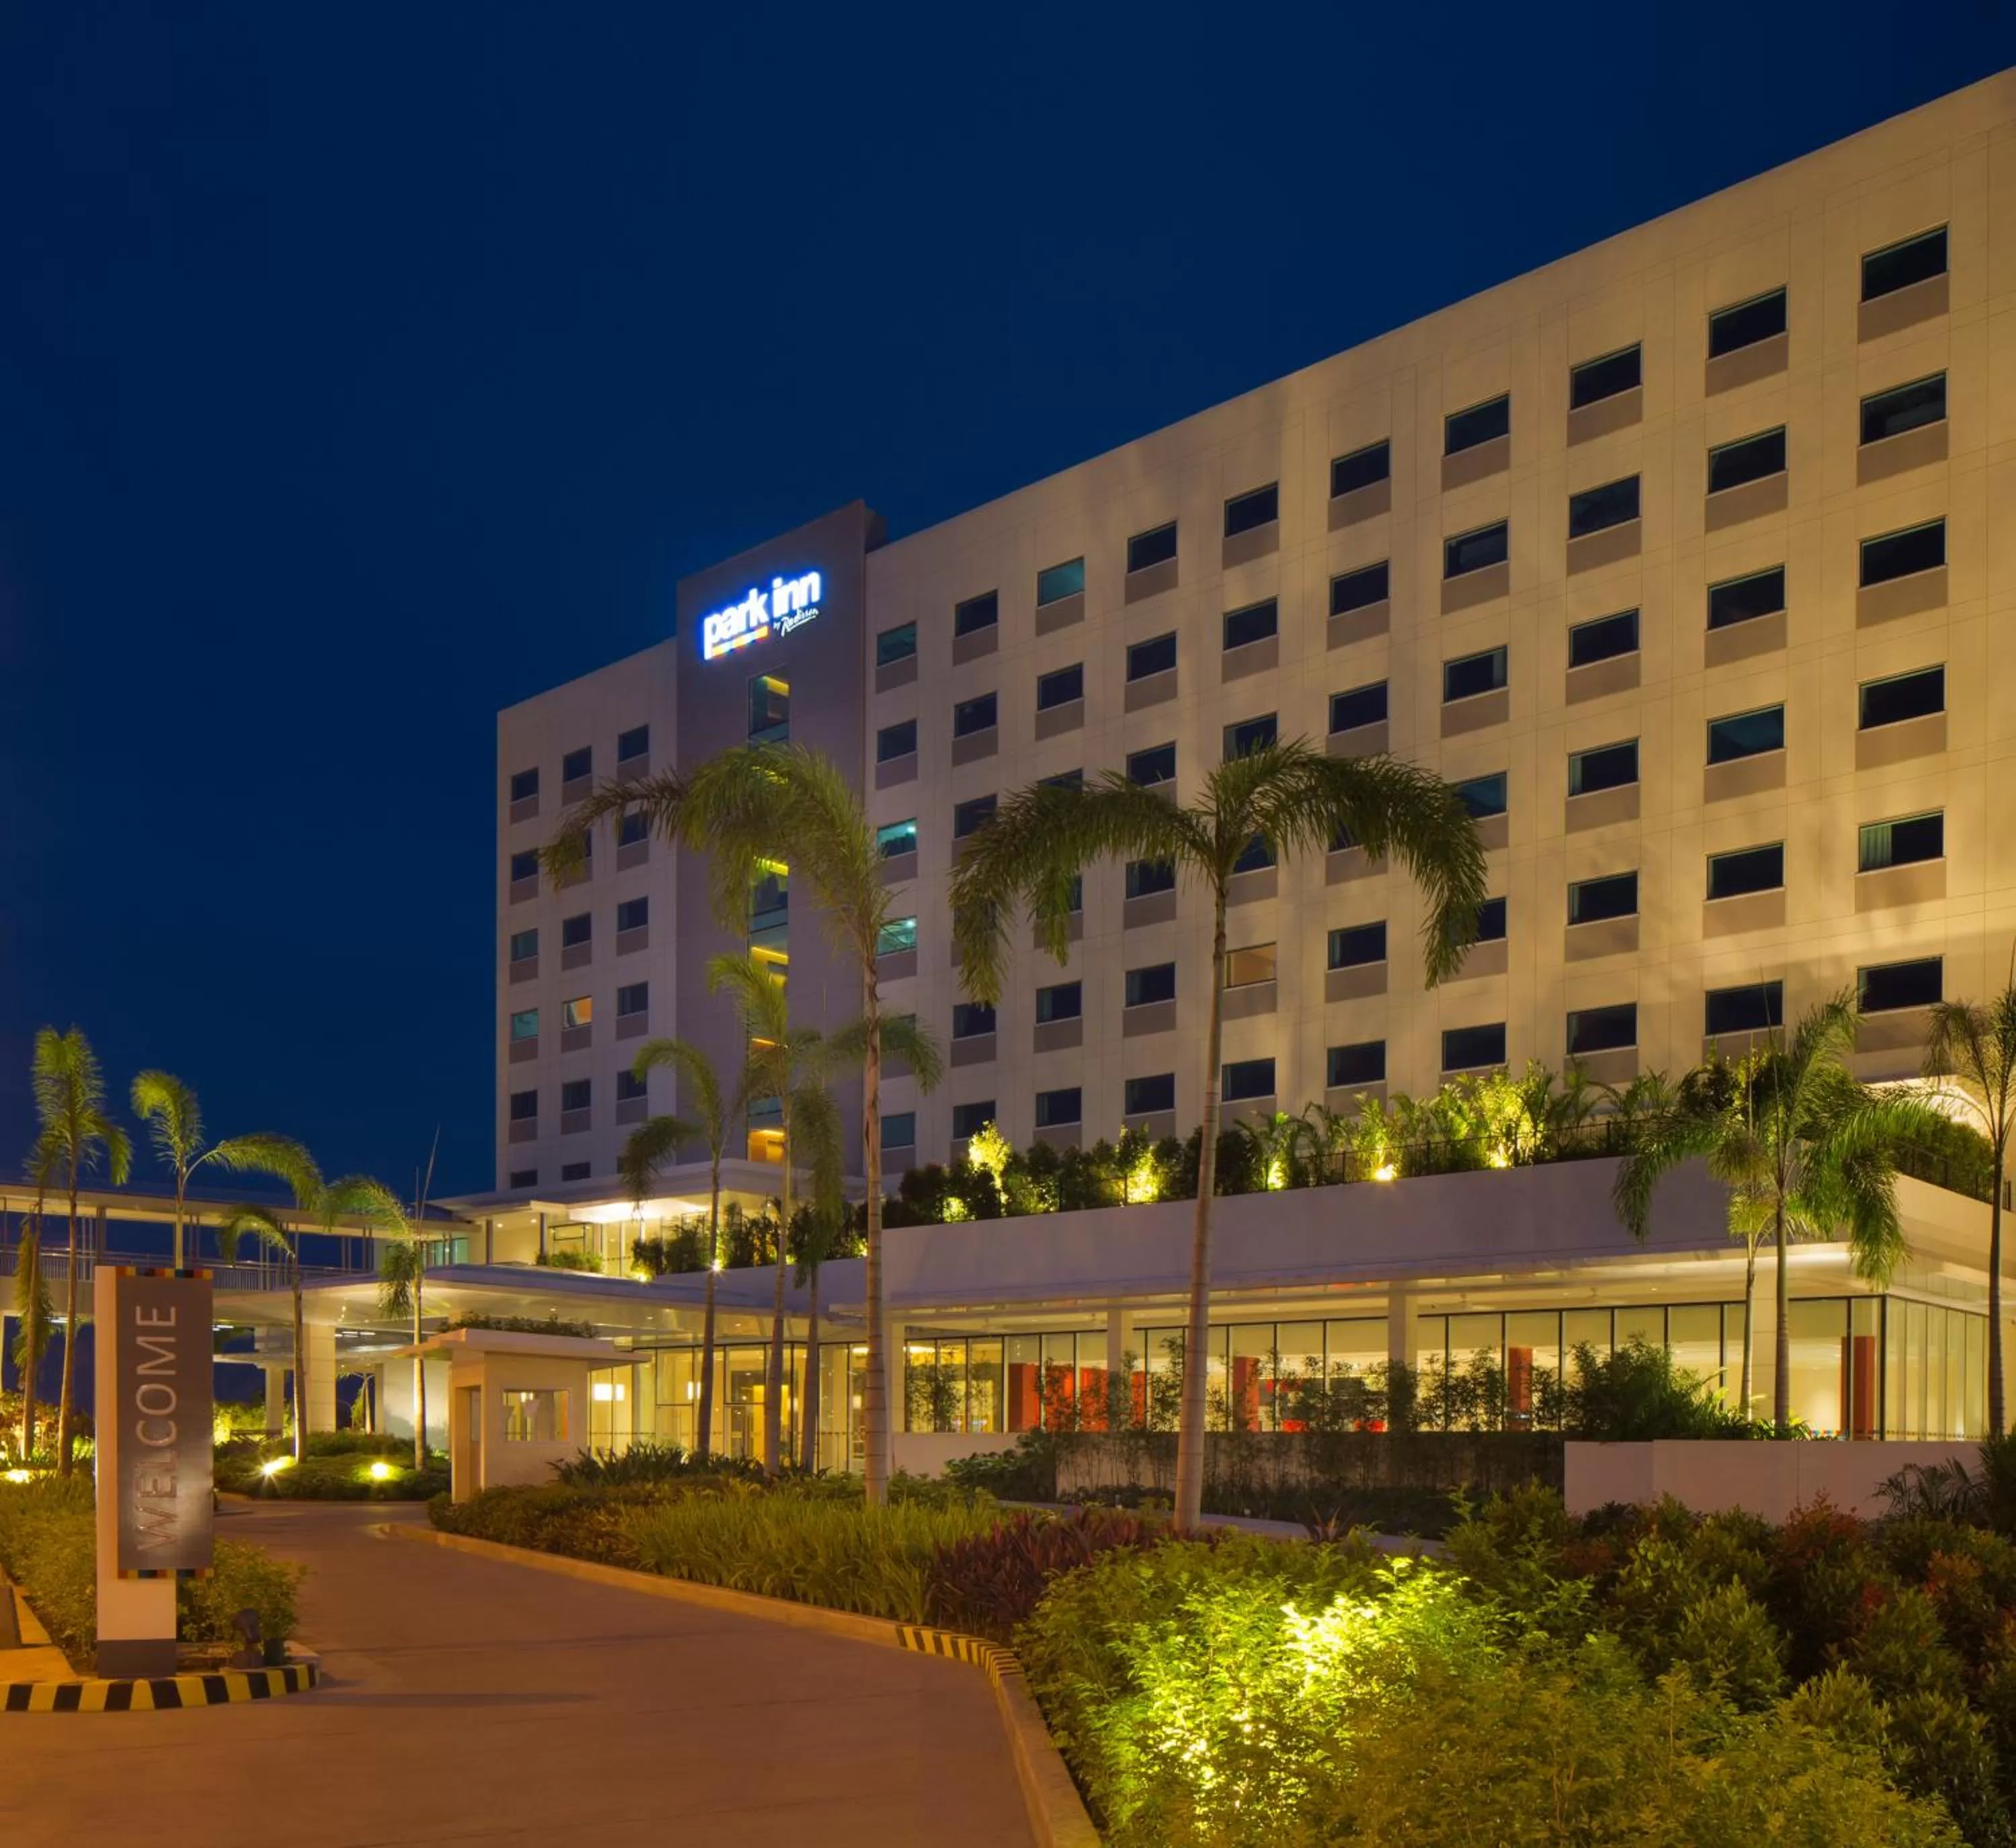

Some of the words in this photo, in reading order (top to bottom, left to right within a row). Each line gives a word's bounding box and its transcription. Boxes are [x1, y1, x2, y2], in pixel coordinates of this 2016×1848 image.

[704, 588, 769, 660] park
[772, 571, 821, 618] inn
[781, 607, 819, 637] Radisson
[135, 1305, 177, 1550] WELCOME
